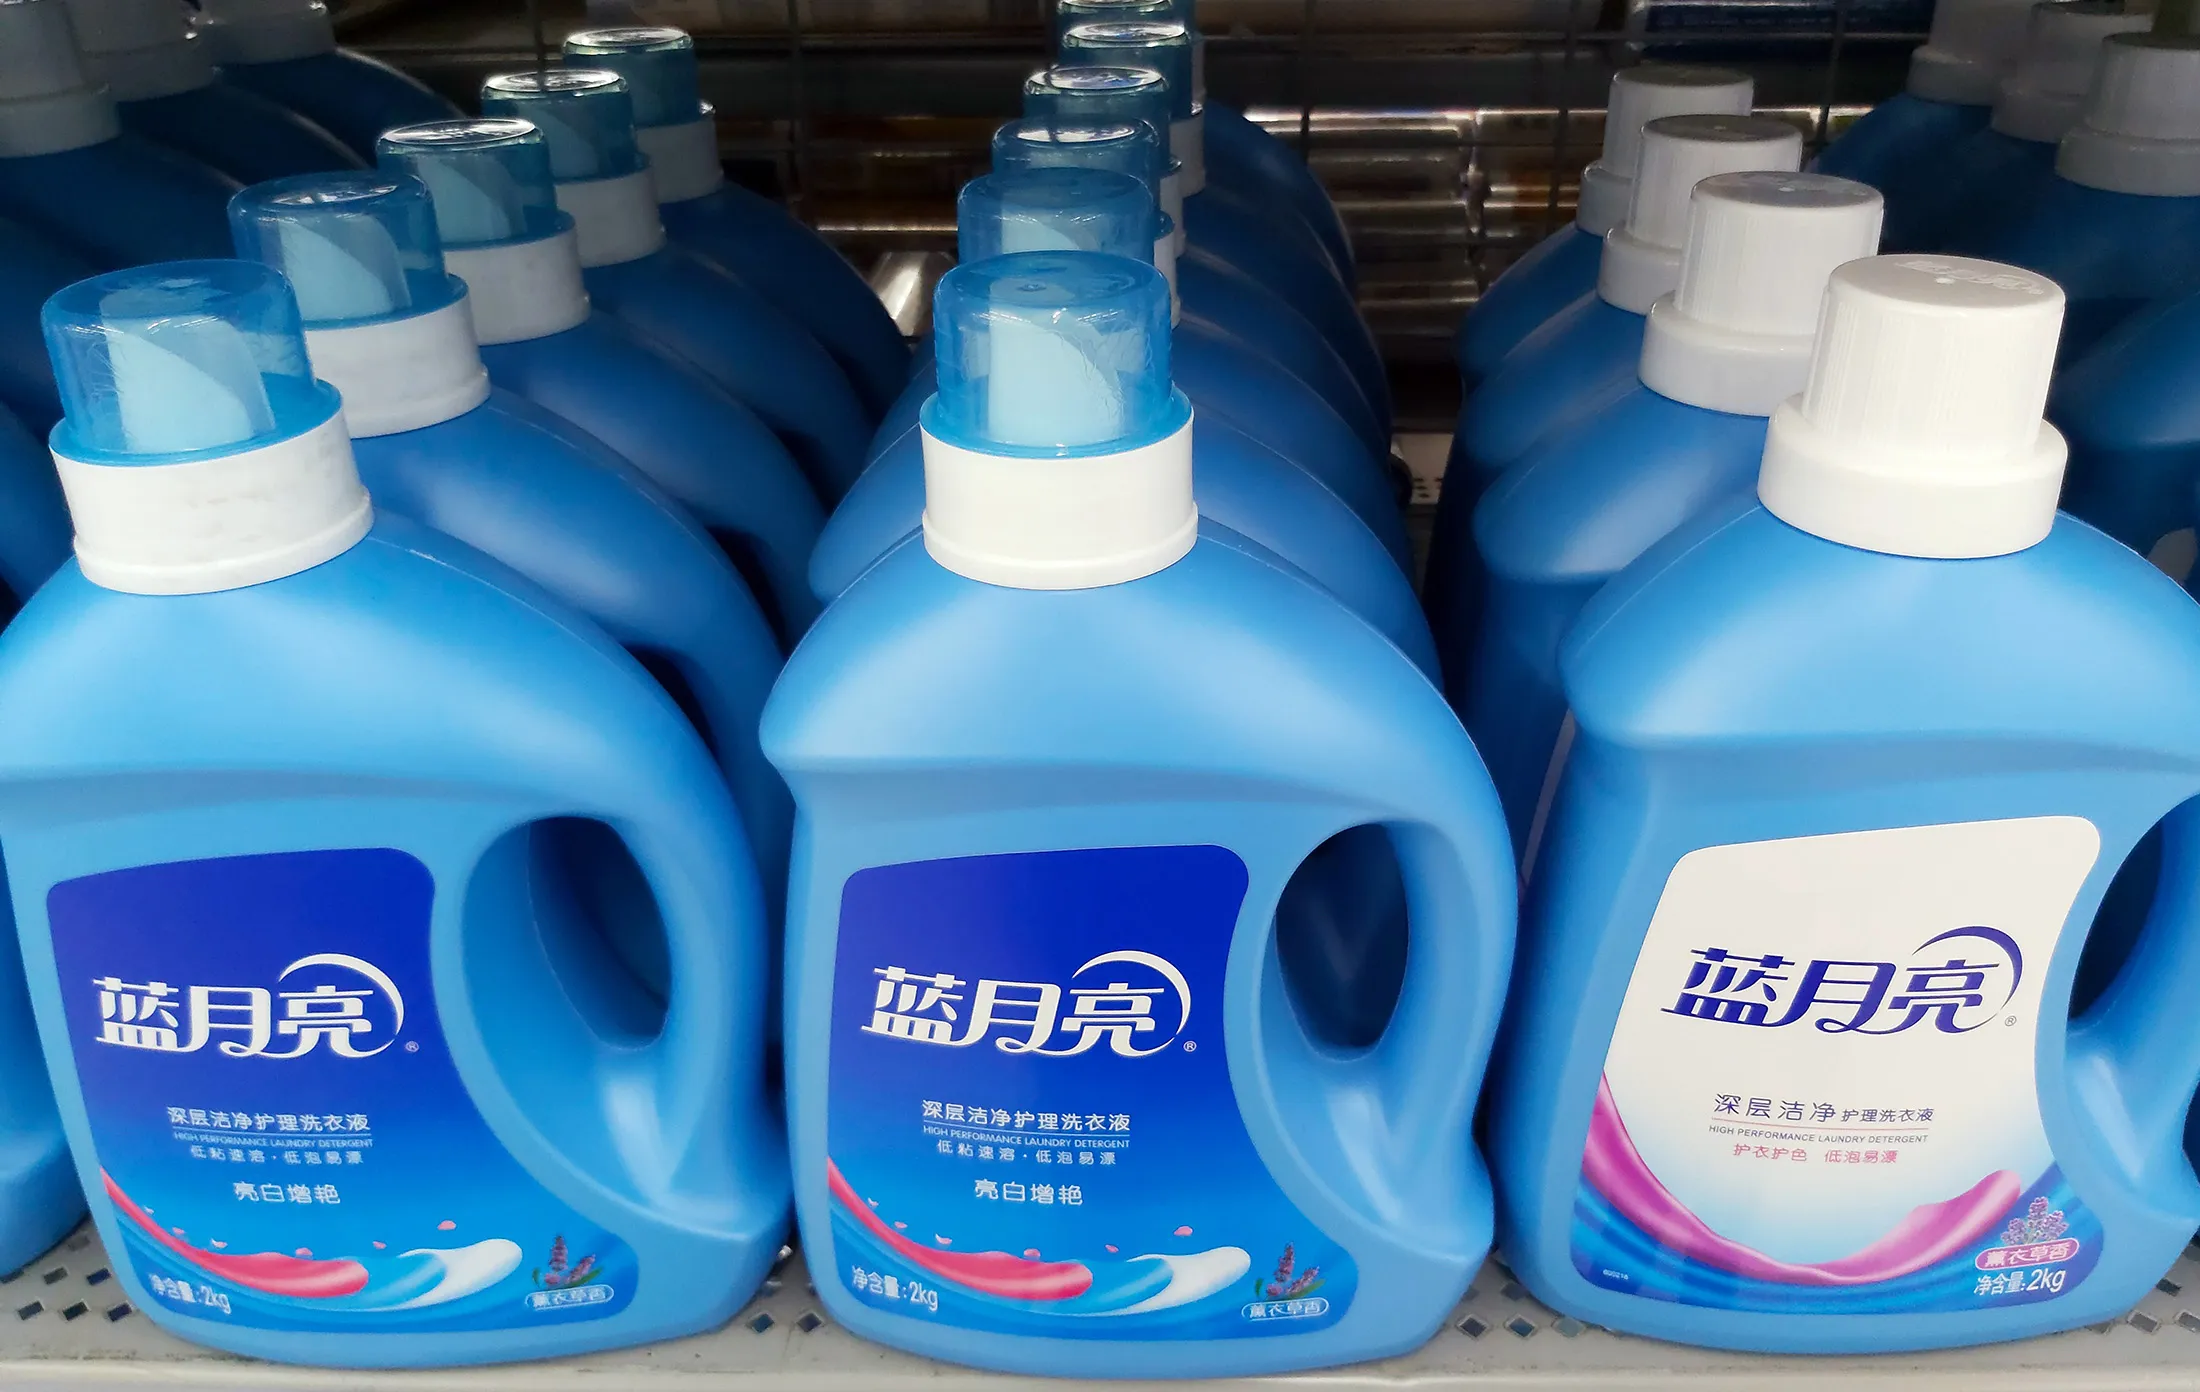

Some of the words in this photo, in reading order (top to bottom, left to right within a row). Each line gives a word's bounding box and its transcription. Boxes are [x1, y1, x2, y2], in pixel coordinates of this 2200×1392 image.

[1660, 925, 2023, 1034] 蓝月亮
[92, 953, 404, 1058] 蓝月亮
[861, 949, 1191, 1057] 蓝月亮
[167, 1106, 371, 1132] 深层洁净护理洗衣液
[921, 1099, 1131, 1132] 深层洁净护理洗衣液
[1713, 1092, 1934, 1123] 深层洁净护理洗衣液
[173, 1131, 199, 1142] HIGH
[200, 1134, 268, 1146] PERFORMANCE
[270, 1138, 316, 1148] LAUNDRY
[318, 1138, 373, 1148] DETERGENT
[923, 1125, 949, 1136] HIGH
[950, 1128, 1022, 1145] PERFORMANCE
[1025, 1136, 1072, 1148] LAUNDRY
[1074, 1138, 1130, 1149] DETERGENT
[1708, 1124, 1734, 1135] HIGH
[1737, 1127, 1815, 1142] PERFORMANCE
[1818, 1134, 1866, 1143] LAUNDRY
[1868, 1134, 1929, 1143] DETERGENT
[1733, 1143, 1807, 1162] 护衣护色
[1824, 1149, 1898, 1164] 低泡易漂
[233, 1181, 340, 1204] 亮白增艳
[974, 1178, 1083, 1206] 亮白增艳
